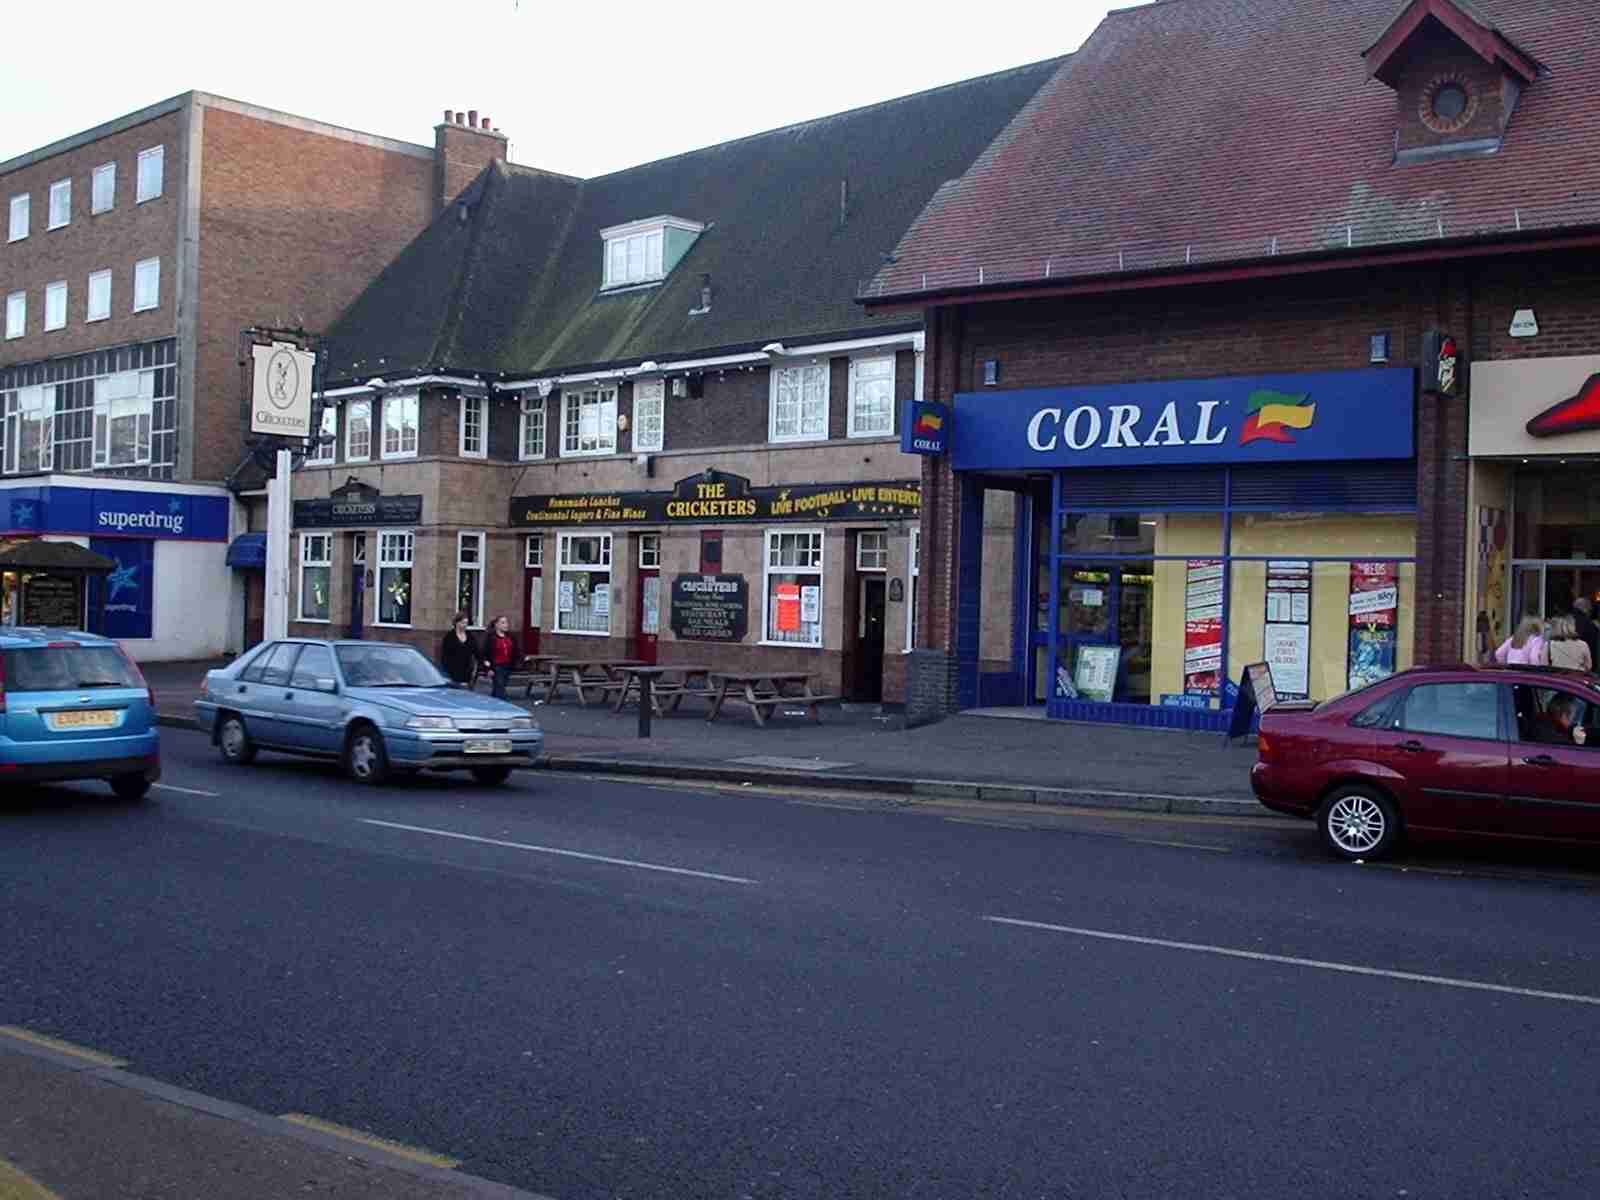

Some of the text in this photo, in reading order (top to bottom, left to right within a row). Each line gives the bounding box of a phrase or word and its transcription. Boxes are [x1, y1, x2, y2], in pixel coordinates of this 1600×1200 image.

[1026, 400, 1229, 452] CORAL
[697, 483, 726, 499] THE
[771, 500, 794, 515] LIVE
[795, 490, 847, 514] FOOTBALL
[852, 487, 875, 501] LIVE
[666, 499, 757, 517] CRICKETERS
[98, 510, 184, 533] superdrug
